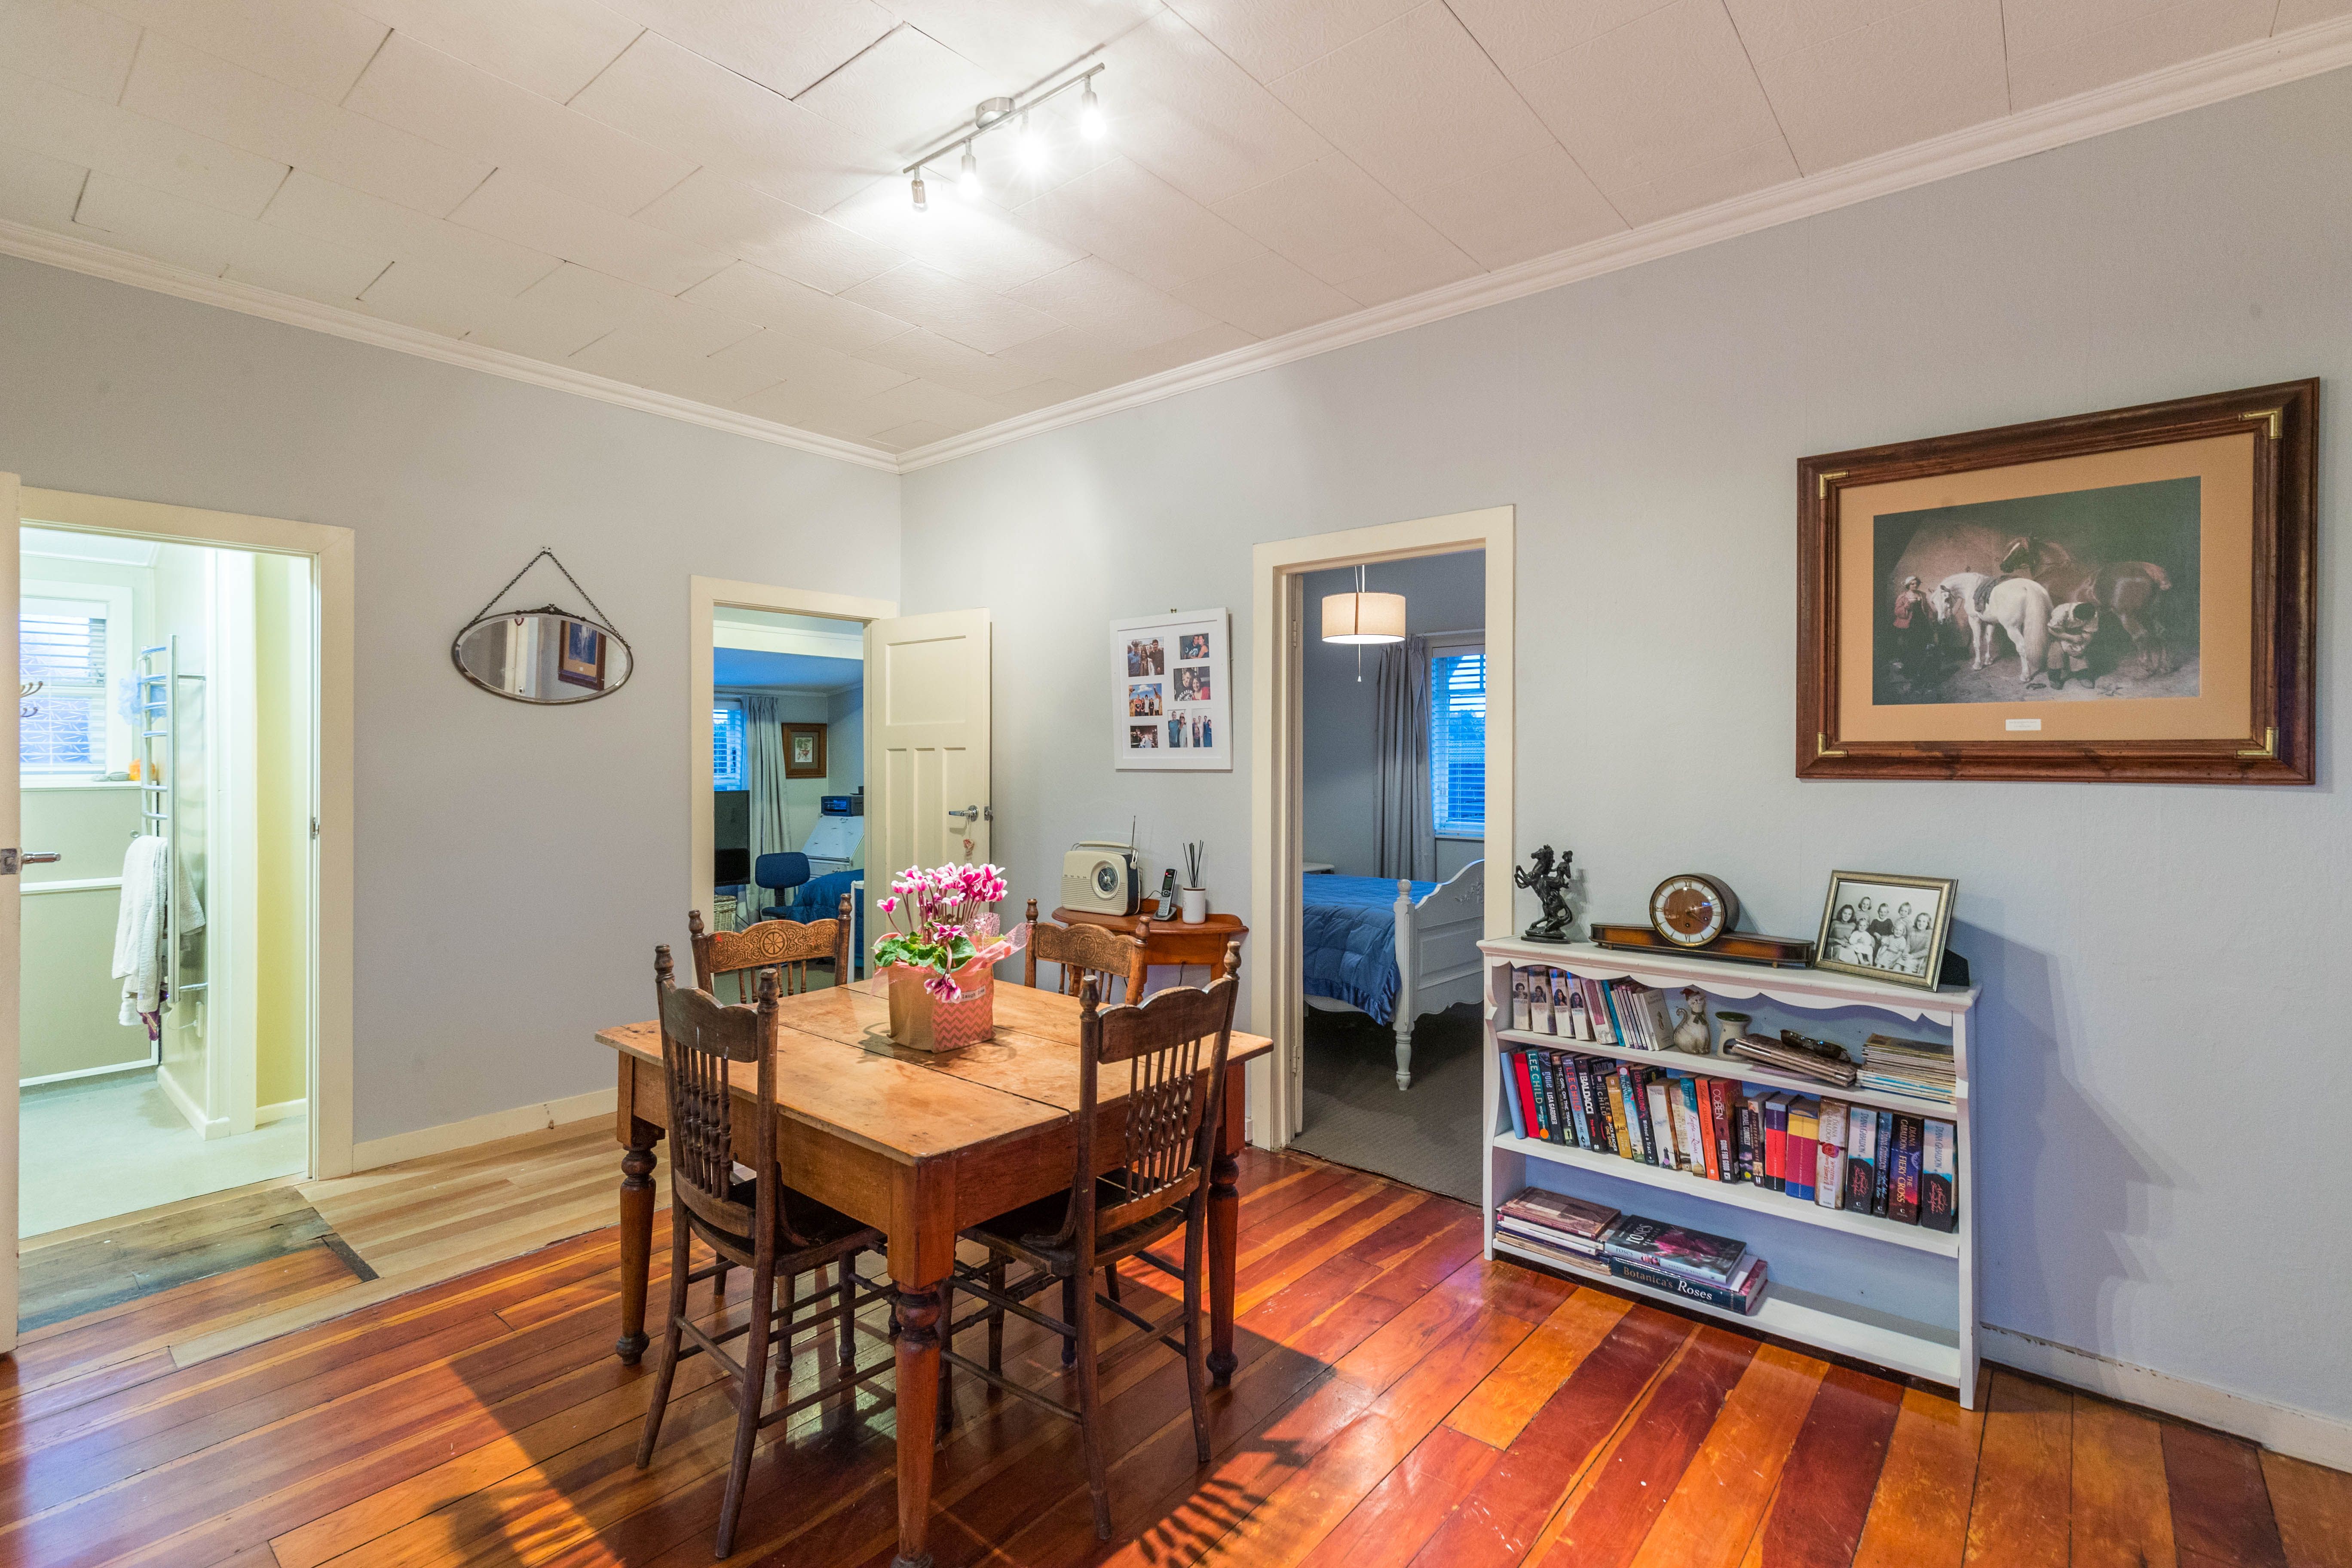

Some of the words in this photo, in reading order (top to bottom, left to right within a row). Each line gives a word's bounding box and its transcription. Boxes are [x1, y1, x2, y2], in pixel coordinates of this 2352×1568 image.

[1528, 1053, 1538, 1071] LEE
[1542, 1072, 1553, 1088] gone
[1566, 1067, 1575, 1083] LEE
[1620, 1075, 1629, 1100] URNIVALL
[1532, 1074, 1543, 1104] CHILD
[1570, 1085, 1581, 1112] CHILD
[1580, 1075, 1594, 1115] BALDACCI
[1636, 1084, 1646, 1112] MARKLUND
[1549, 1102, 1557, 1125] GARDNER
[1597, 1091, 1607, 1116] CHILD
[1713, 1089, 1724, 1120] COBEN
[1687, 1115, 1699, 1133] Before
[1860, 1112, 1869, 1128] DIANA
[1690, 1138, 1700, 1154] Rains
[1859, 1127, 1867, 1154] GABALDON
[1880, 1130, 1889, 1145] DIANA
[1899, 1119, 1908, 1150] GABALDON
[1935, 1126, 1944, 1142] DIANA
[1879, 1145, 1887, 1170] GABALDON
[1898, 1155, 1907, 1176] FIERY
[1934, 1141, 1943, 1169] GABALDON
[1897, 1177, 1906, 1203] CROSS
[1626, 1224, 1653, 1244] roses
[1616, 1247, 1633, 1256] roses
[1624, 1266, 1673, 1289] Botanica's
[1678, 1280, 1713, 1300] Roses
